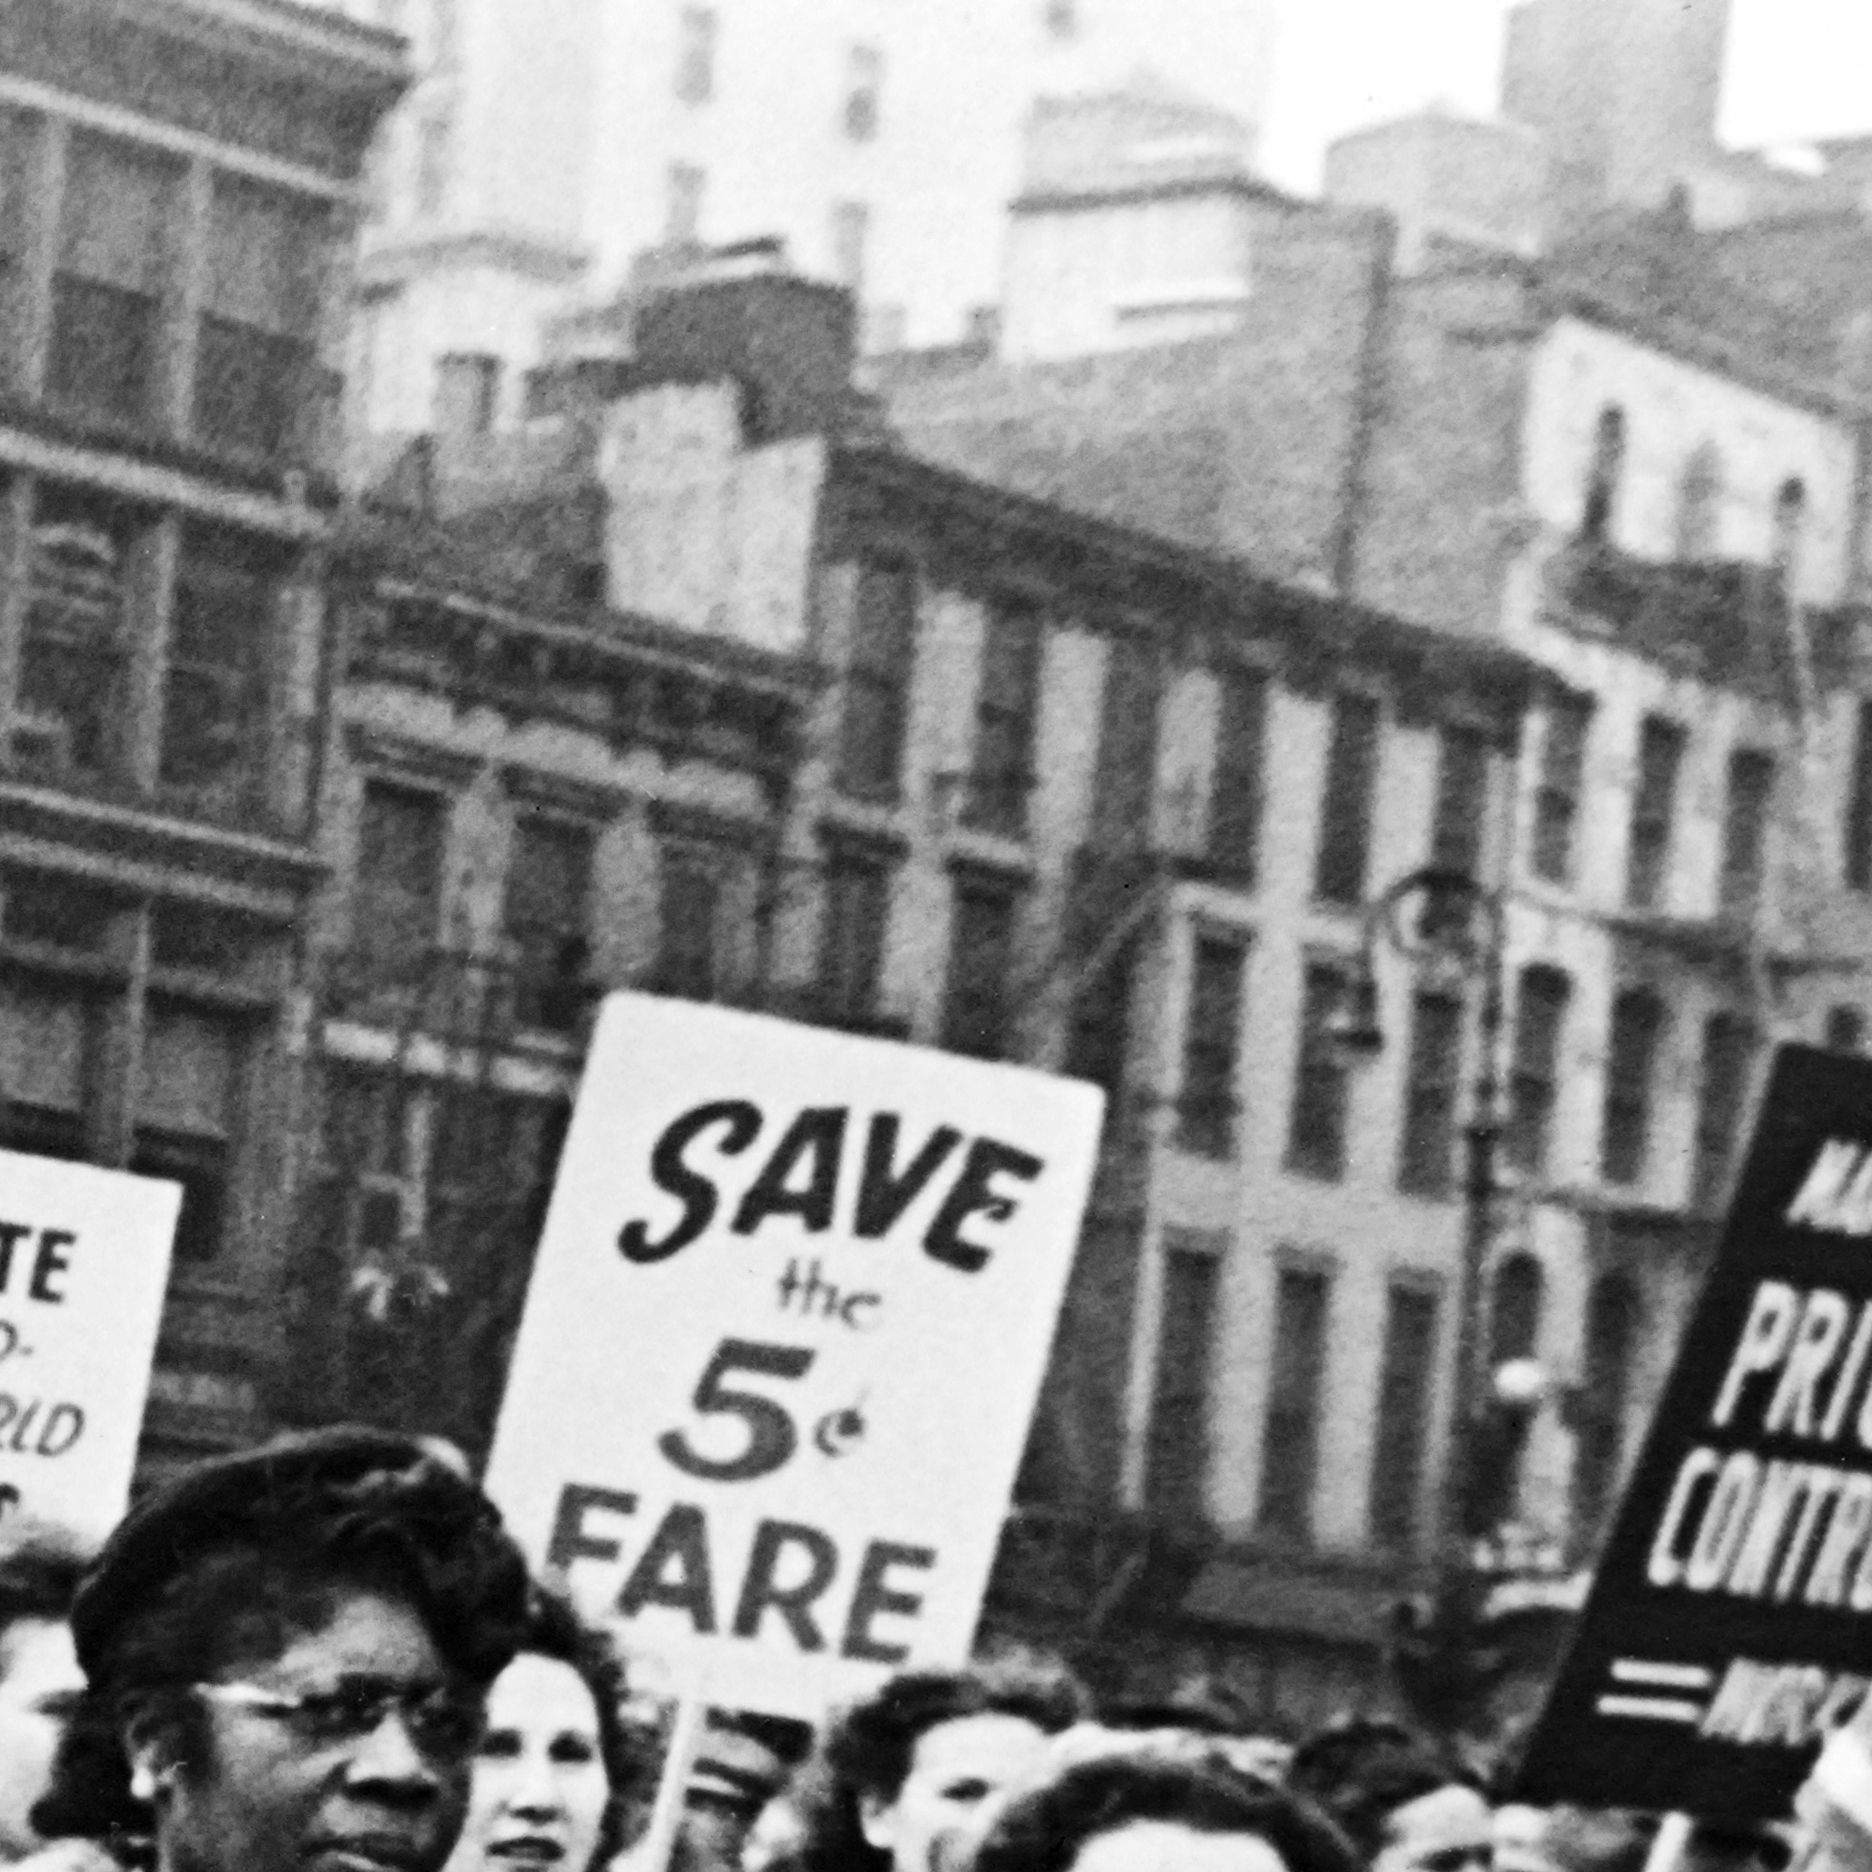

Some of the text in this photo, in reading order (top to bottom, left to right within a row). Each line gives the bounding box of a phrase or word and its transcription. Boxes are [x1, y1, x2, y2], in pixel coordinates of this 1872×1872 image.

[616, 1097, 1045, 1273] SAVE
[775, 1256, 884, 1334] the
[1710, 1279, 1872, 1448] PRI
[546, 1482, 939, 1666] FARE
[1647, 1445, 1872, 1611] CONTR
